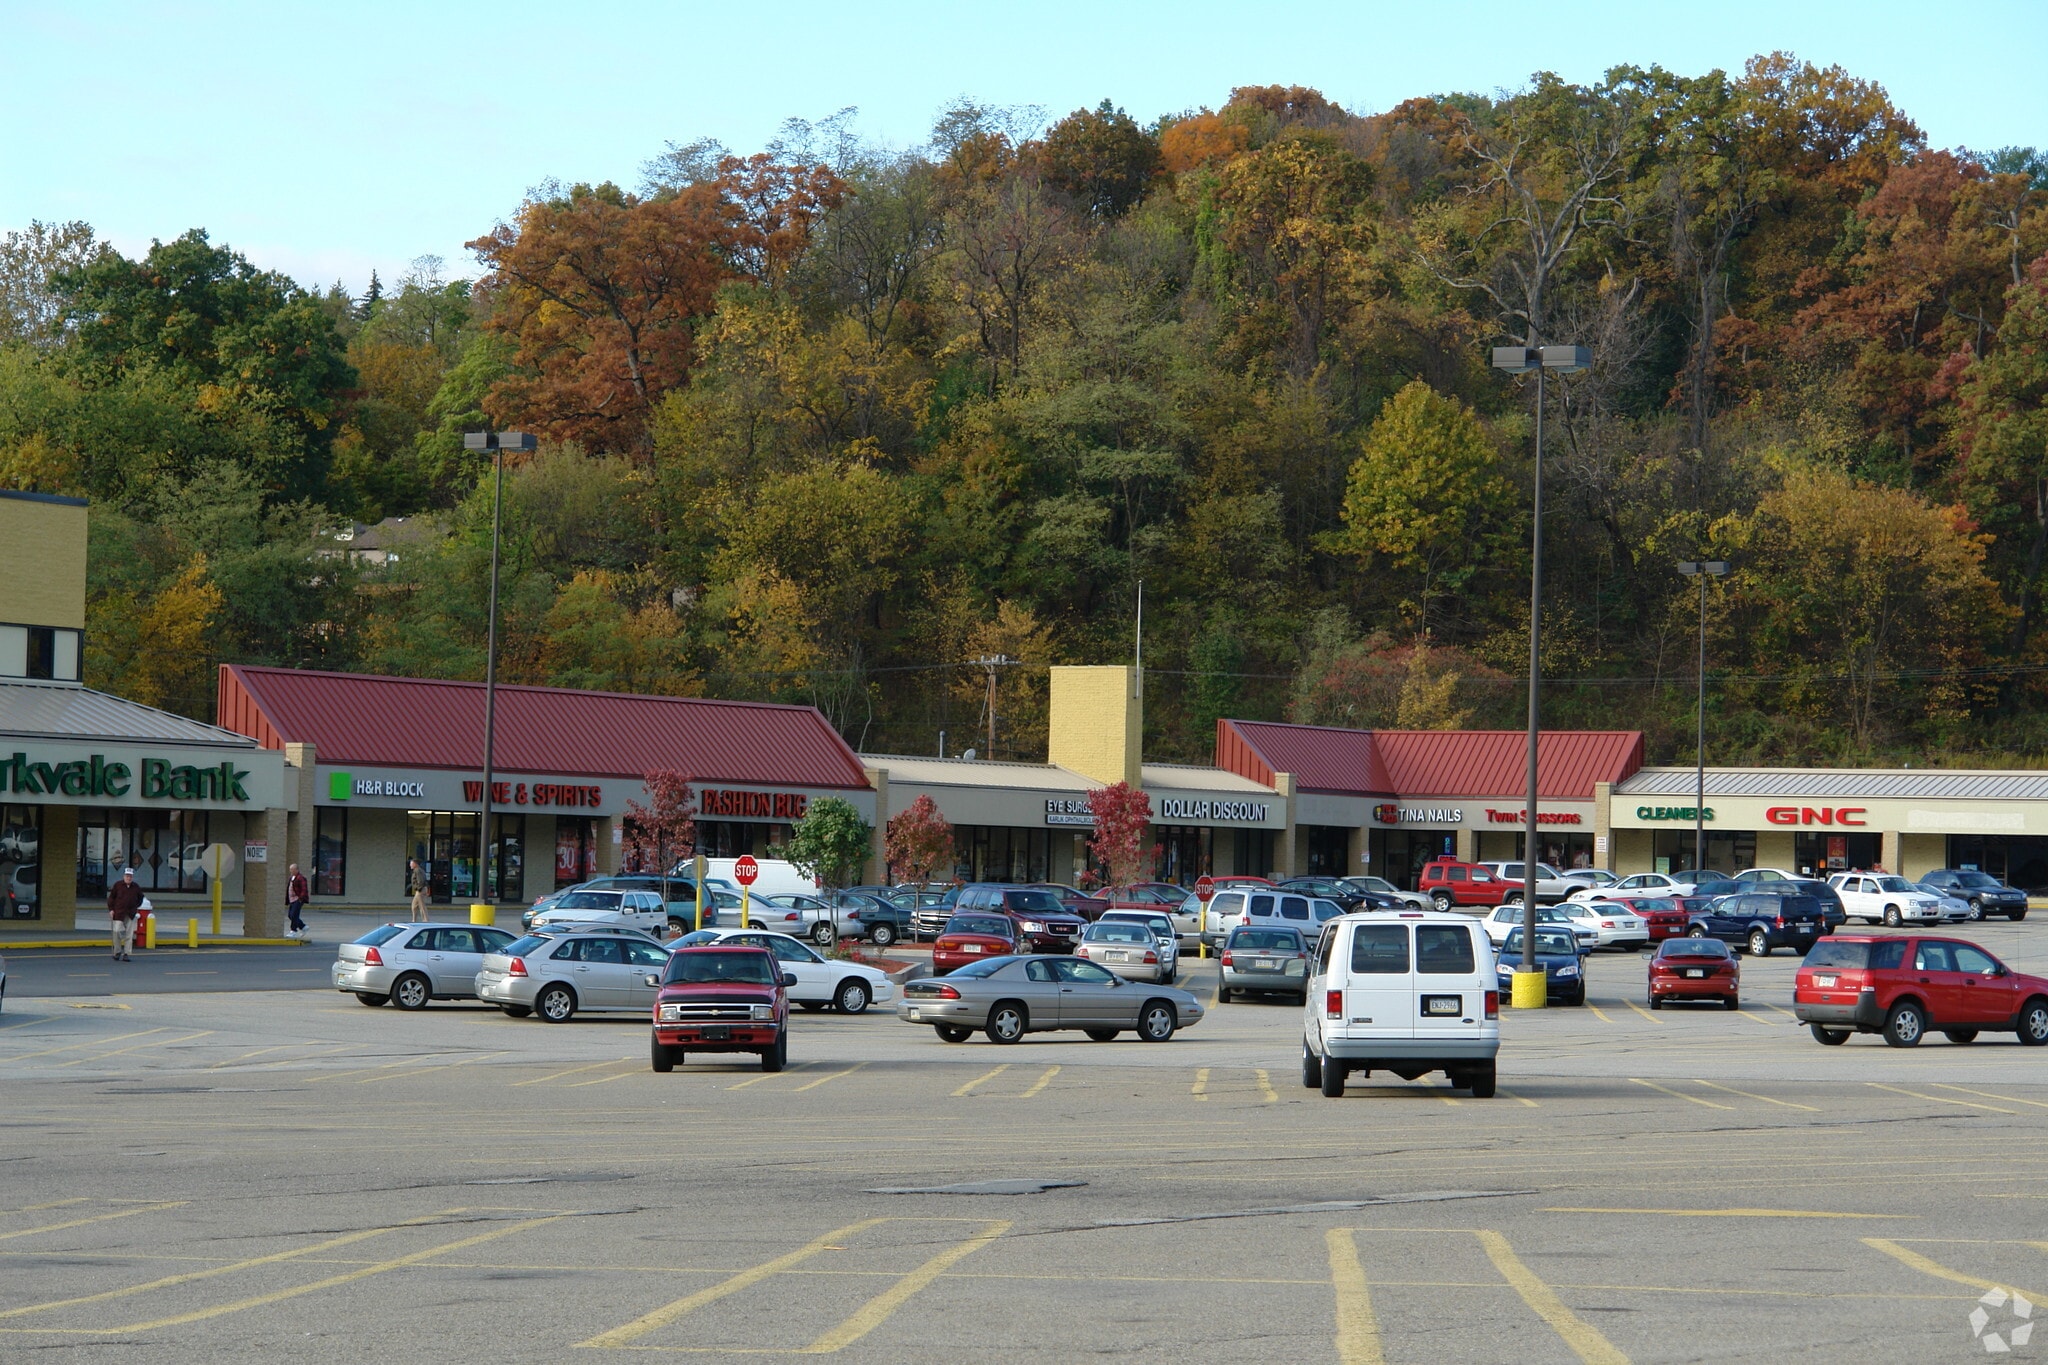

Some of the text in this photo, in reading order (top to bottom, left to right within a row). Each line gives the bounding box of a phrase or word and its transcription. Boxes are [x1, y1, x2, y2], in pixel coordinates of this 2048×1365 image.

[141, 758, 251, 801] Bank
[355, 780, 424, 798] H&R BLOCK
[463, 781, 602, 808] WNE & SPIRITS
[701, 789, 808, 819] FASHION BUG
[1046, 800, 1063, 812] EYE
[1162, 799, 1269, 821] DOLLAR DISCOUNT
[1398, 808, 1425, 822] TINA
[1428, 808, 1462, 822] NAILS
[1520, 809, 1582, 824] SISSORS
[1766, 807, 1866, 826] GNC
[246, 847, 256, 858] NO
[559, 846, 575, 869] 30
[735, 864, 757, 877] STOP
[1196, 885, 1214, 895] STOP
